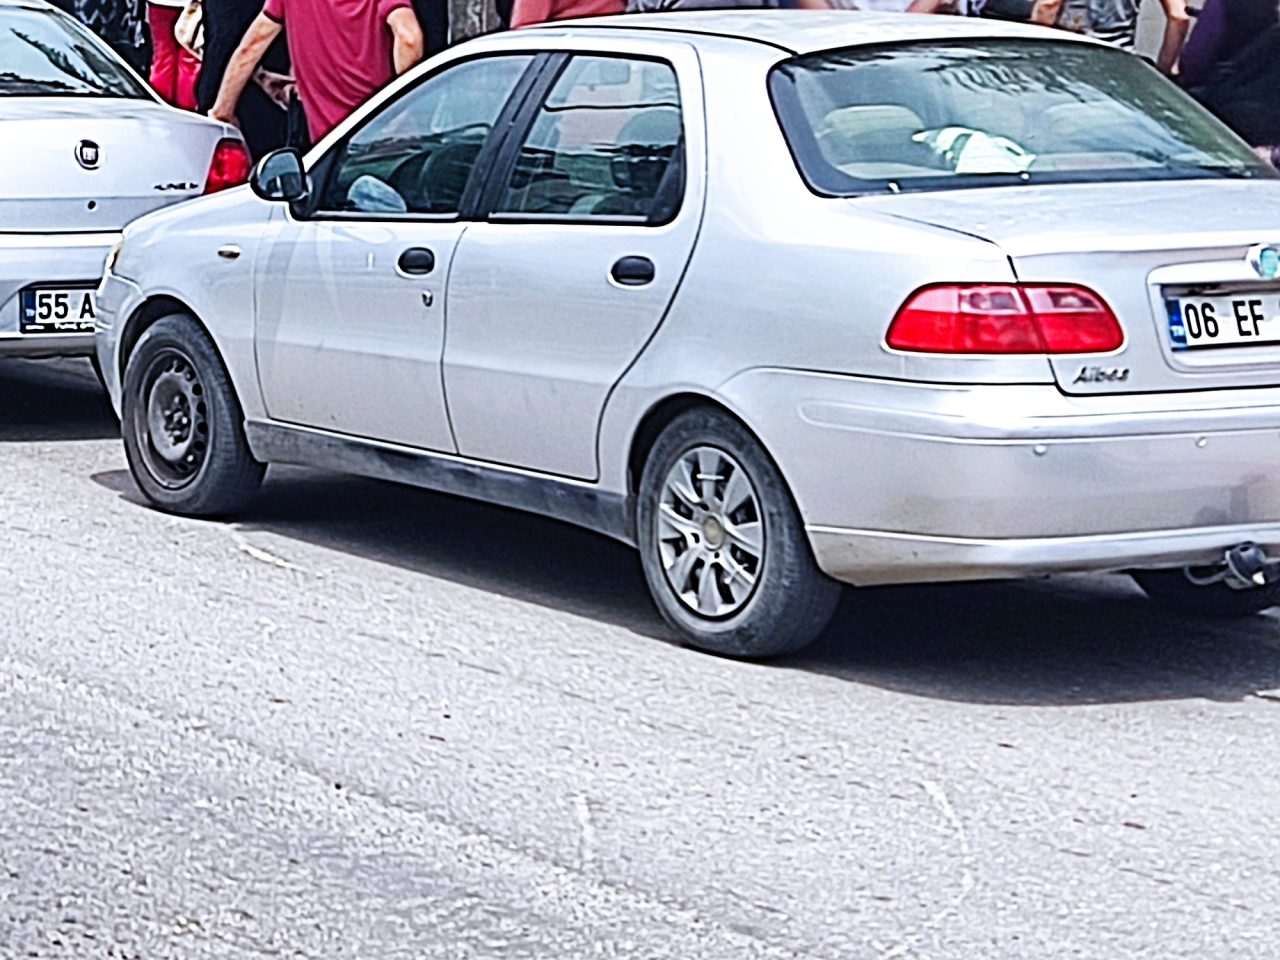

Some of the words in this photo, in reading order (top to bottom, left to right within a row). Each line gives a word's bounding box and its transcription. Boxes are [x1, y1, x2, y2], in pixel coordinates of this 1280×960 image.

[37, 292, 69, 320] 55
[1184, 302, 1219, 339] 06
[1232, 299, 1265, 337] EF
